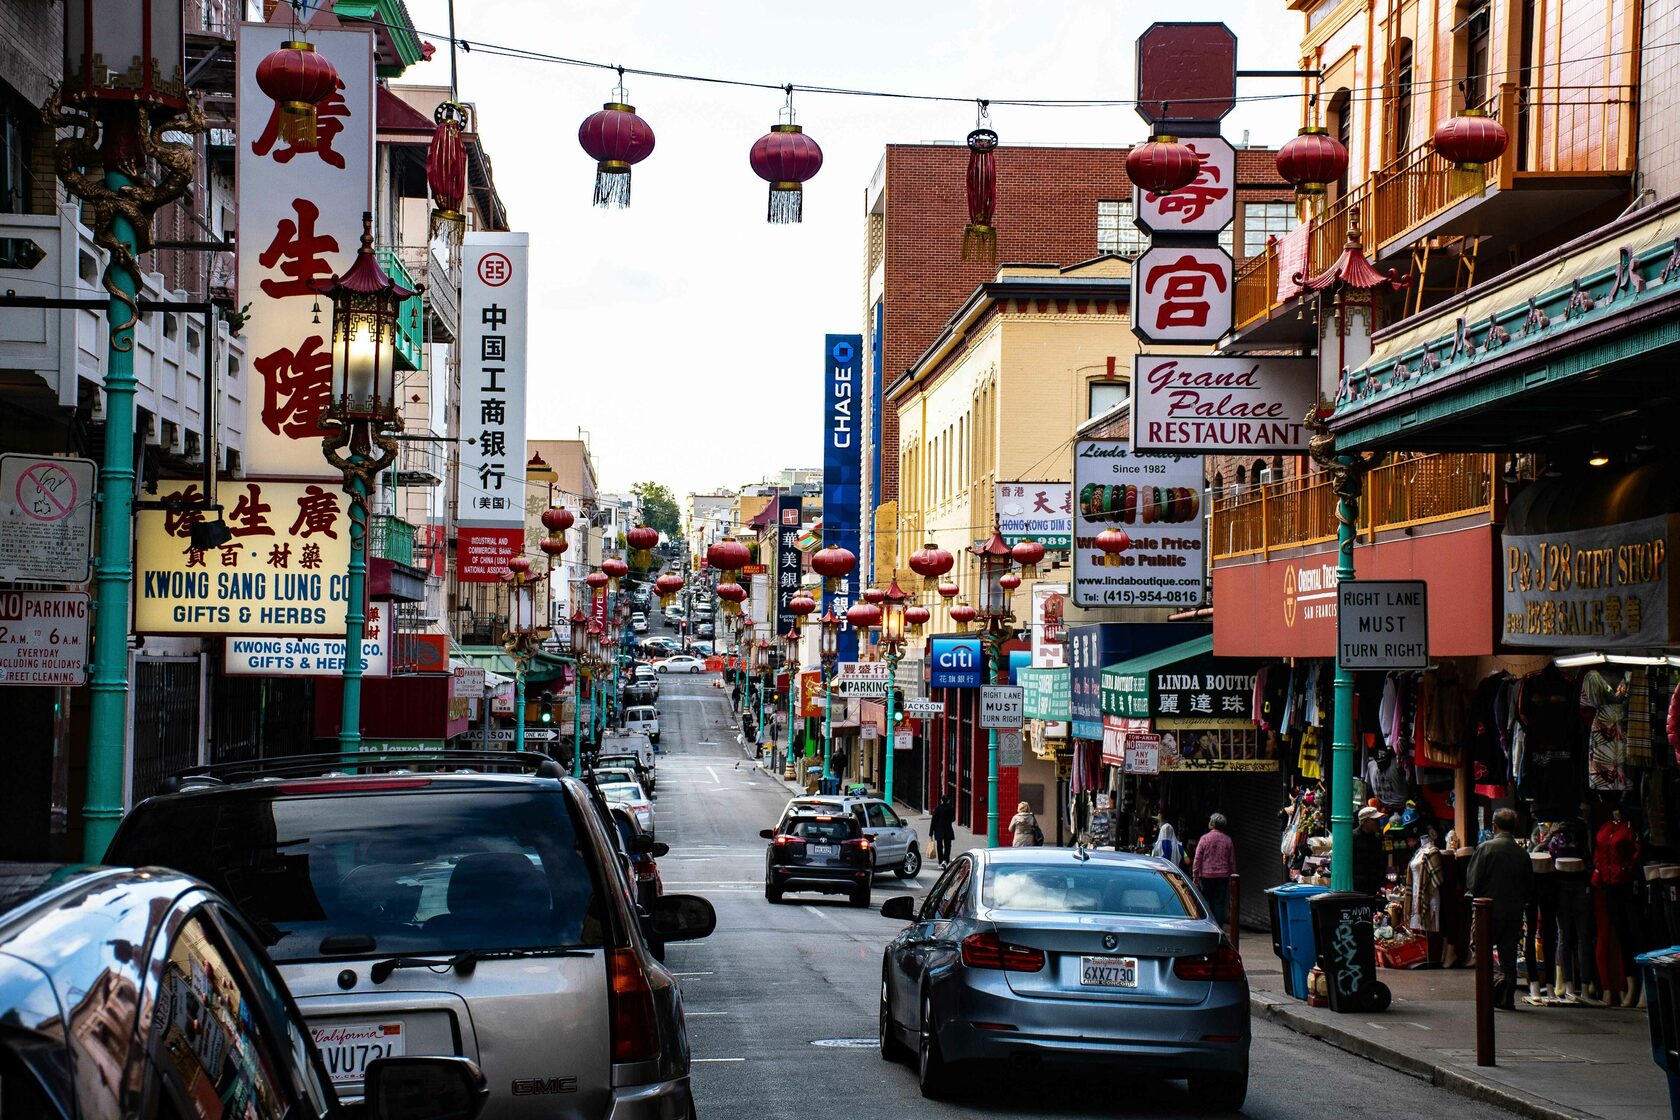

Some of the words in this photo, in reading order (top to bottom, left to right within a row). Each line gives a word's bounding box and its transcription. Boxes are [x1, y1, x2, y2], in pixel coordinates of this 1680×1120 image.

[1147, 360, 1260, 393] Grand
[479, 303, 506, 490] 中国工商银行
[1167, 390, 1283, 417] Palace
[835, 367, 851, 448] CHASE
[1149, 422, 1301, 445] RESTAURANT
[1080, 443, 1128, 458] Linda
[1112, 465, 1140, 474] Since
[1143, 465, 1166, 474] 1982
[1002, 486, 1024, 497] 香港
[1002, 519, 1024, 531] HONG
[1026, 519, 1048, 531] KONG
[1050, 519, 1064, 531] DIM
[471, 537, 497, 545] INDUSTRIAL
[498, 537, 508, 545] AND
[1162, 537, 1201, 550] Price
[468, 546, 498, 554] COMMERCIAL
[499, 547, 512, 555] BANK
[471, 556, 479, 564] OF
[480, 556, 494, 564] CHINA
[1138, 554, 1187, 567] Public
[1575, 548, 1614, 589] GIFT
[1618, 538, 1665, 586] SHOP
[487, 566, 511, 574] ASSOCIATI
[145, 571, 209, 599] KWONG
[218, 572, 266, 600] SANG
[274, 573, 321, 601] LUNG
[1078, 576, 1201, 587] www.lindaboutique.com
[1298, 568, 1321, 592] ORIENTAL
[1084, 593, 1099, 601] Tel:
[1103, 590, 1197, 604] (415)-954-0816
[1343, 592, 1380, 606] RIGHT
[1387, 592, 1421, 606] LANE
[25, 600, 85, 618] PARKING
[173, 605, 230, 623] GIFTS
[239, 606, 251, 623] &
[260, 607, 326, 624] HERBS
[1304, 607, 1314, 620] SAN
[1315, 603, 1337, 618] FRANCIS
[1359, 615, 1406, 633] MUST
[1558, 600, 1605, 636] SALE
[10, 635, 29, 644] A.M.
[49, 628, 60, 645] 6
[62, 635, 81, 646] A.M.
[17, 648, 60, 658] EVERYDAY
[234, 641, 281, 654] KWONG
[285, 642, 320, 655] SANG
[324, 643, 347, 655] TON
[363, 644, 383, 656] CO.
[1344, 643, 1378, 657] TURN
[1385, 643, 1423, 657] RIGHT
[0, 659, 38, 668] NCLUDING
[42, 660, 81, 669] HOLIDAYS
[248, 656, 294, 668] GIFTS
[300, 657, 311, 669] &
[316, 657, 369, 670] HERS
[940, 649, 972, 668] citi
[32, 672, 74, 681] CLEANING
[1158, 674, 1200, 690] LINDA
[848, 681, 889, 692] PARKING
[983, 691, 1001, 699] RIGHT
[986, 703, 1018, 711] MUST
[983, 714, 1000, 722] TURN
[462, 731, 512, 739] JACSON
[1126, 740, 1135, 749] NO
[1136, 742, 1158, 750] STOPPING
[1134, 758, 1149, 766] TIME
[1084, 966, 1133, 982] 6XXZ730
[315, 1027, 384, 1046] California
[511, 1076, 577, 1096] GMC
